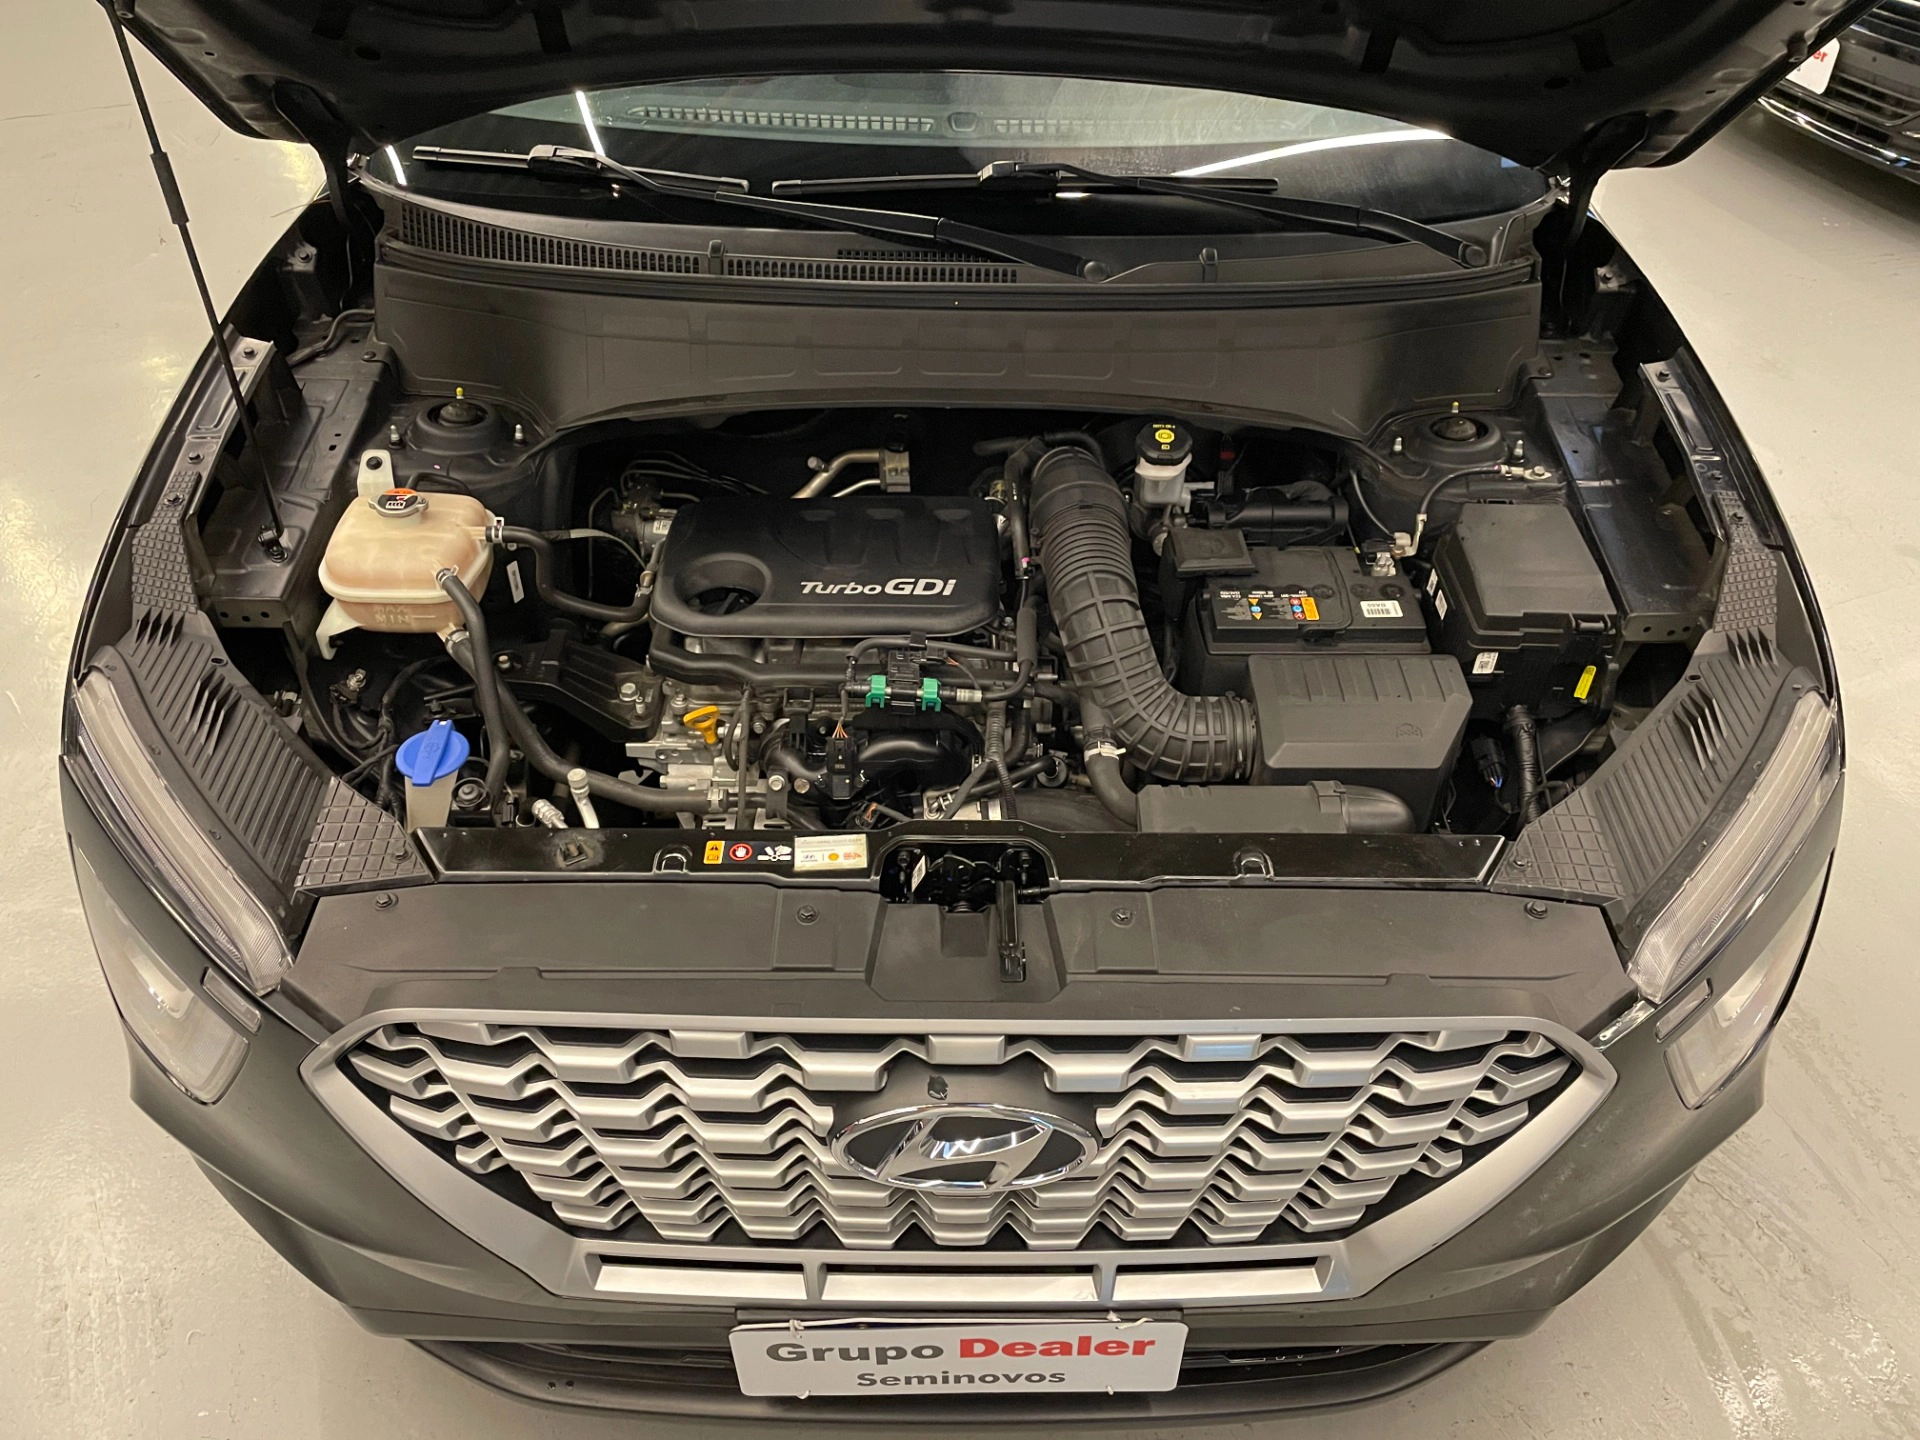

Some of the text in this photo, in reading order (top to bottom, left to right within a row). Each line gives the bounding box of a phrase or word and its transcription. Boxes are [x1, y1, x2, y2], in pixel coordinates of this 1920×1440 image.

[375, 614, 410, 624] MIN
[765, 1336, 1157, 1364] Grupo Dealer
[856, 1370, 1067, 1388] Seminovos
